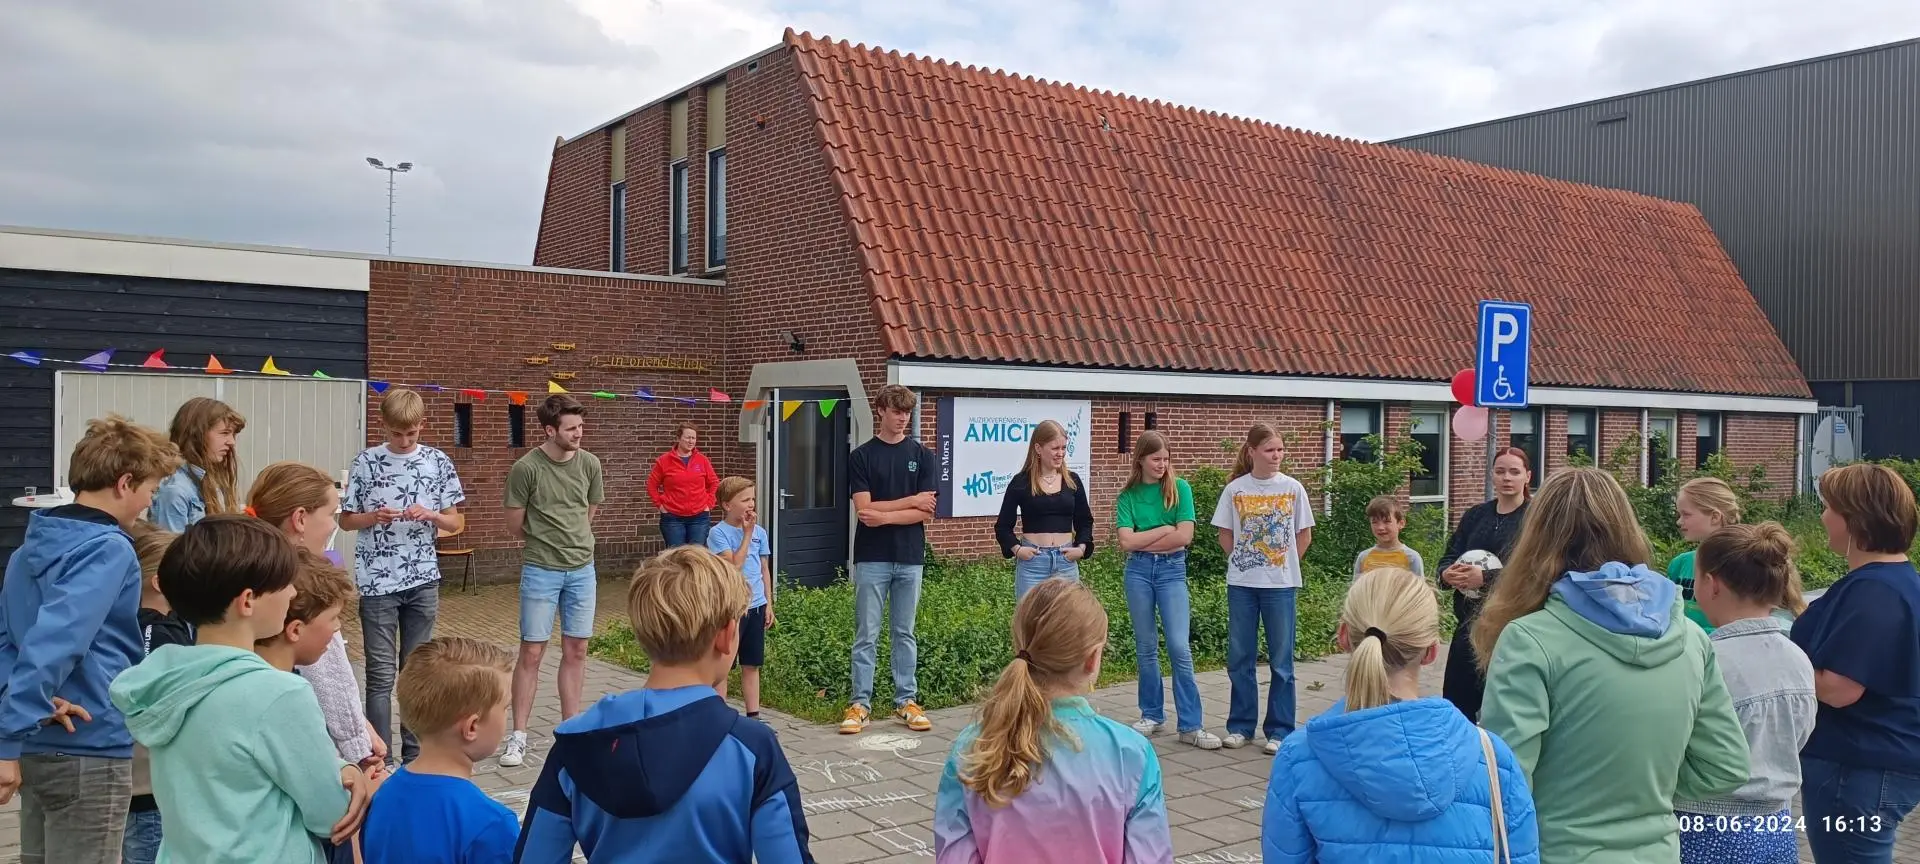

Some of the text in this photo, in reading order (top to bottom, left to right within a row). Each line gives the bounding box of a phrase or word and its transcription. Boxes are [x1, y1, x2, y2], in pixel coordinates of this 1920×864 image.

[1491, 313, 1519, 362] P
[941, 441, 950, 466] Mors
[941, 467, 950, 481] De
[962, 470, 993, 498] HOT
